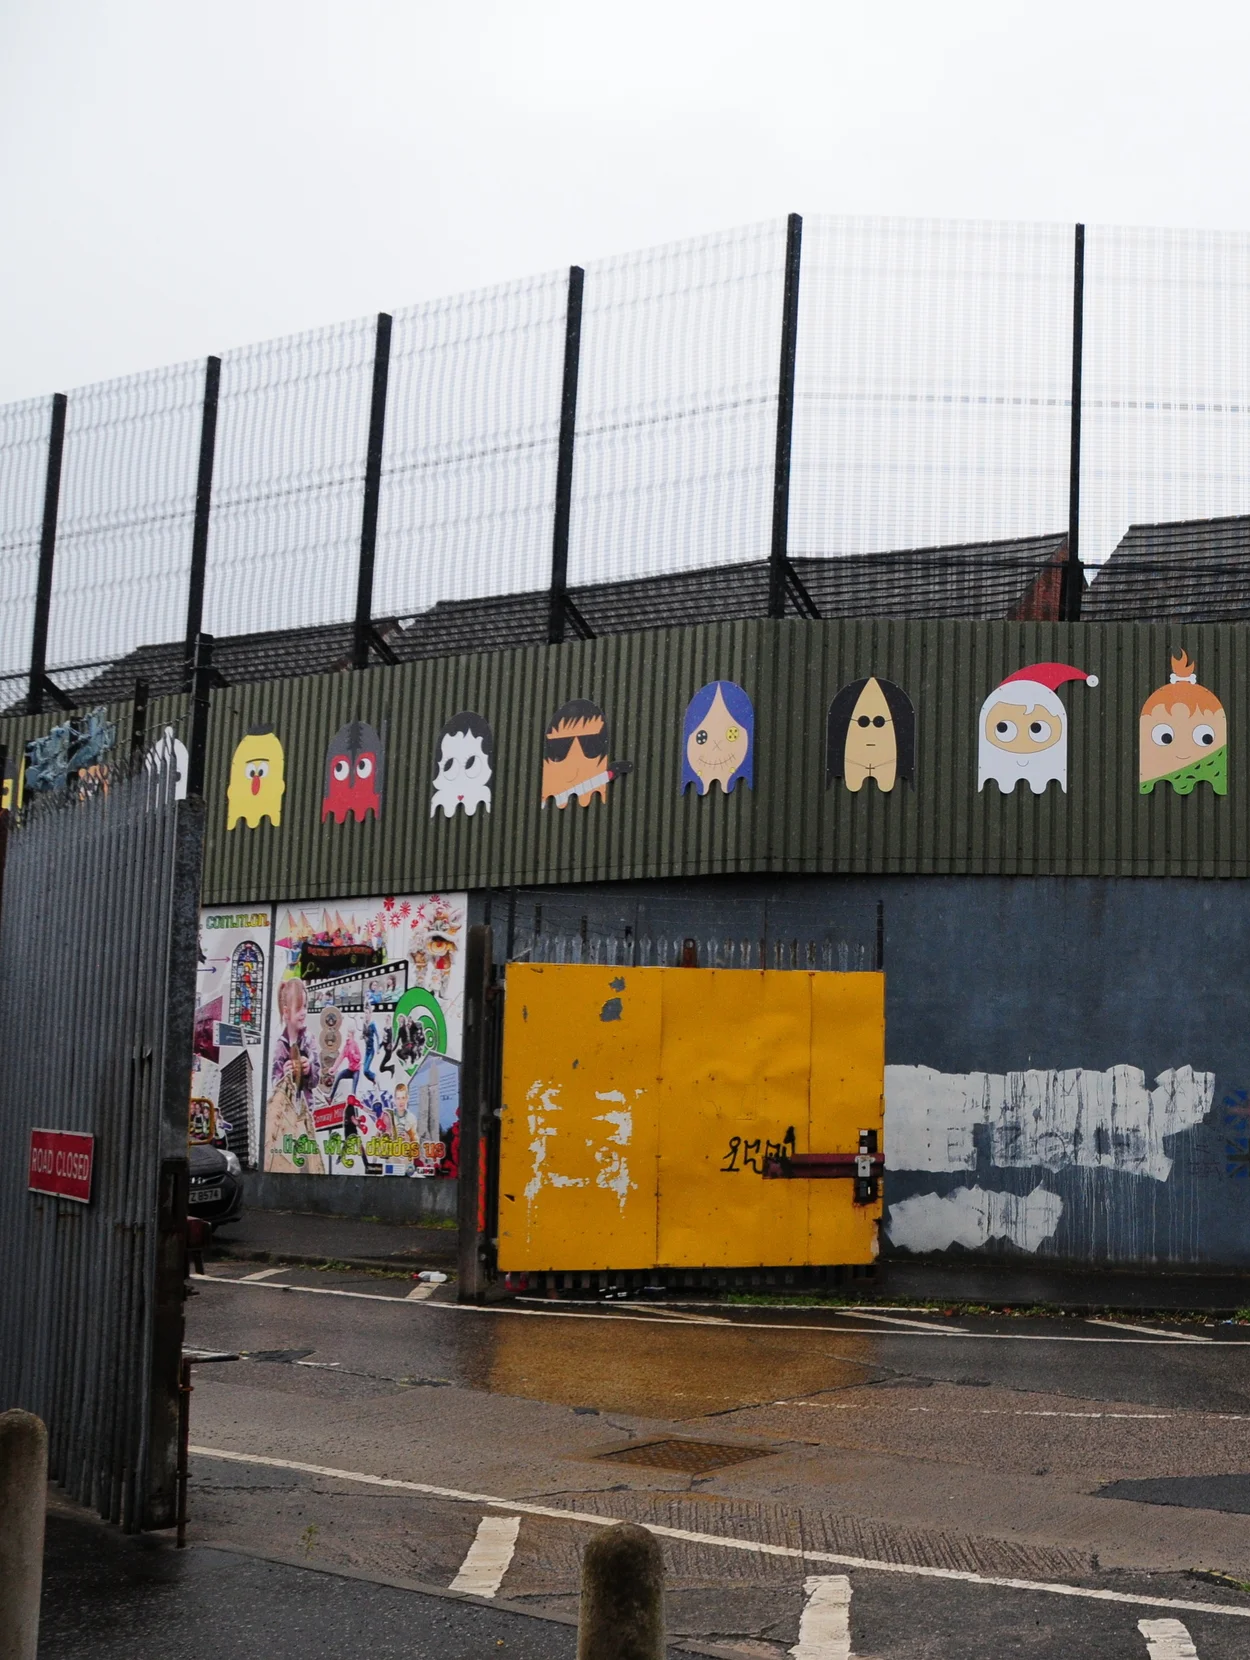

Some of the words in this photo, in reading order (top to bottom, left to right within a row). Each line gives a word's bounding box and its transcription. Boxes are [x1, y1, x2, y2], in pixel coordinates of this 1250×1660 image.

[366, 1134, 420, 1161] divides
[423, 1142, 446, 1161] us
[31, 1147, 53, 1174] ROAD
[56, 1150, 89, 1181] CLOSED
